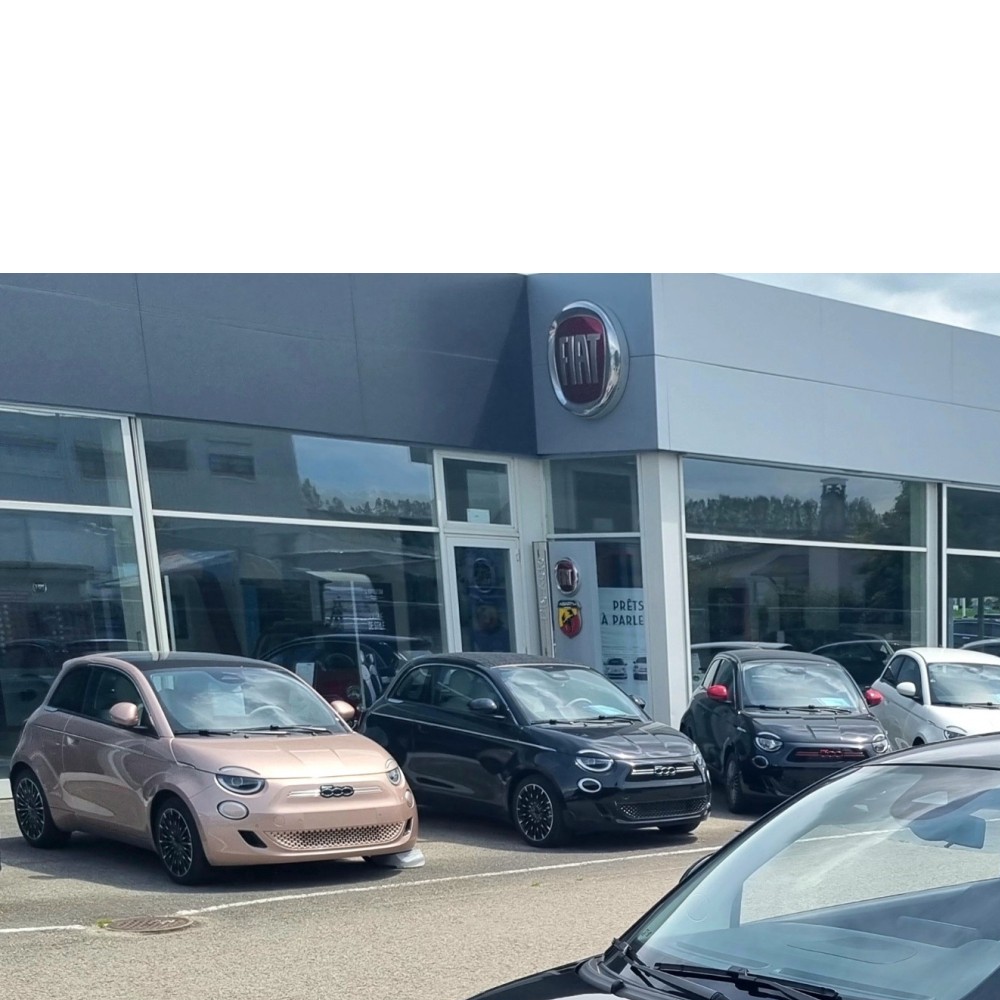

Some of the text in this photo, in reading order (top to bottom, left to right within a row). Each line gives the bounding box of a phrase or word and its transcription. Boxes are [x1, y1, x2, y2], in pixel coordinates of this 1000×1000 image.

[560, 333, 601, 386] FIAT
[613, 598, 645, 611] PRÊTS
[601, 612, 609, 626] À
[320, 784, 354, 798] 500
